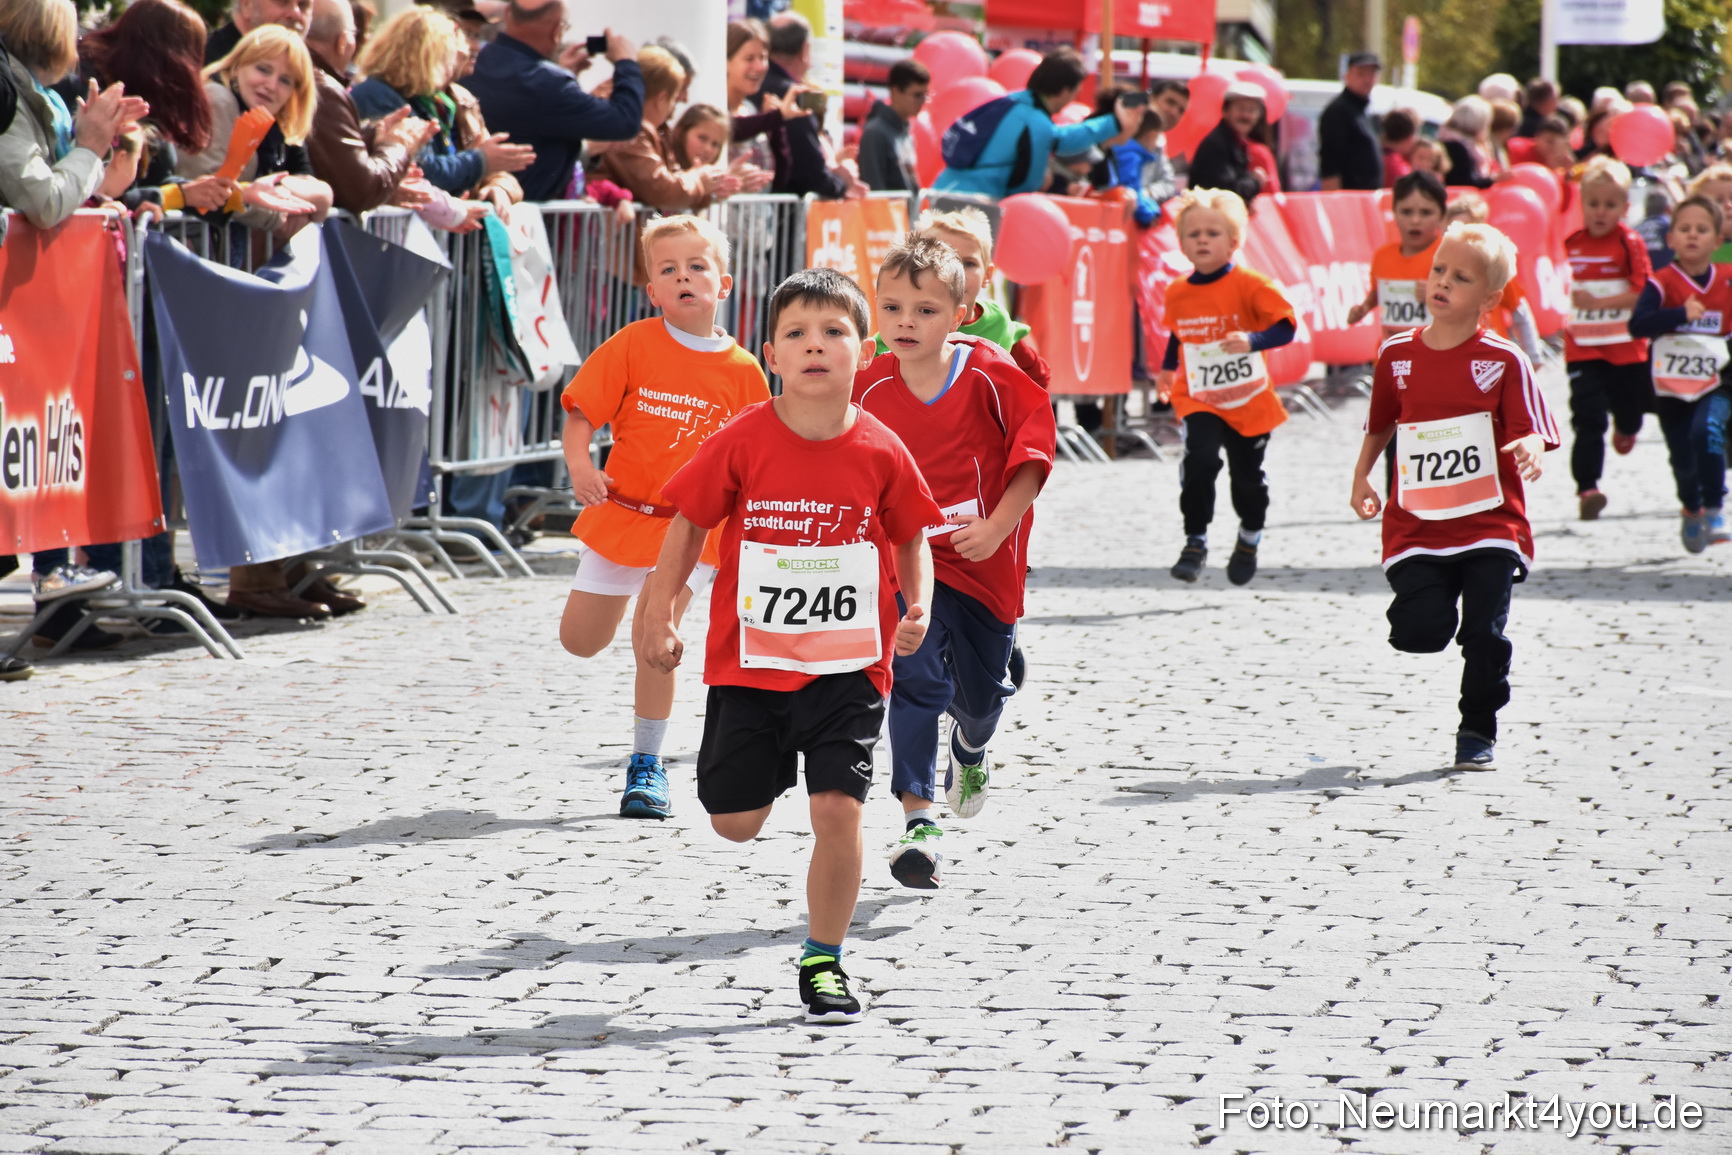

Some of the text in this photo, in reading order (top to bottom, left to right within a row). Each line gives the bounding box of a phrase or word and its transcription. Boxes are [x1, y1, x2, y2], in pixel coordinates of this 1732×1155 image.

[1384, 301, 1426, 322] 7004
[1198, 356, 1253, 386] 7265
[1664, 354, 1717, 376] 7233
[638, 387, 709, 409] Neumarkter
[637, 401, 693, 424] Stadtlauf
[45, 398, 83, 485] Hits
[1409, 445, 1481, 482] 7226
[746, 498, 834, 514] Neumarkter
[743, 516, 814, 534] Stadtlauf
[791, 558, 840, 571] BOCK
[759, 585, 857, 625] 7246
